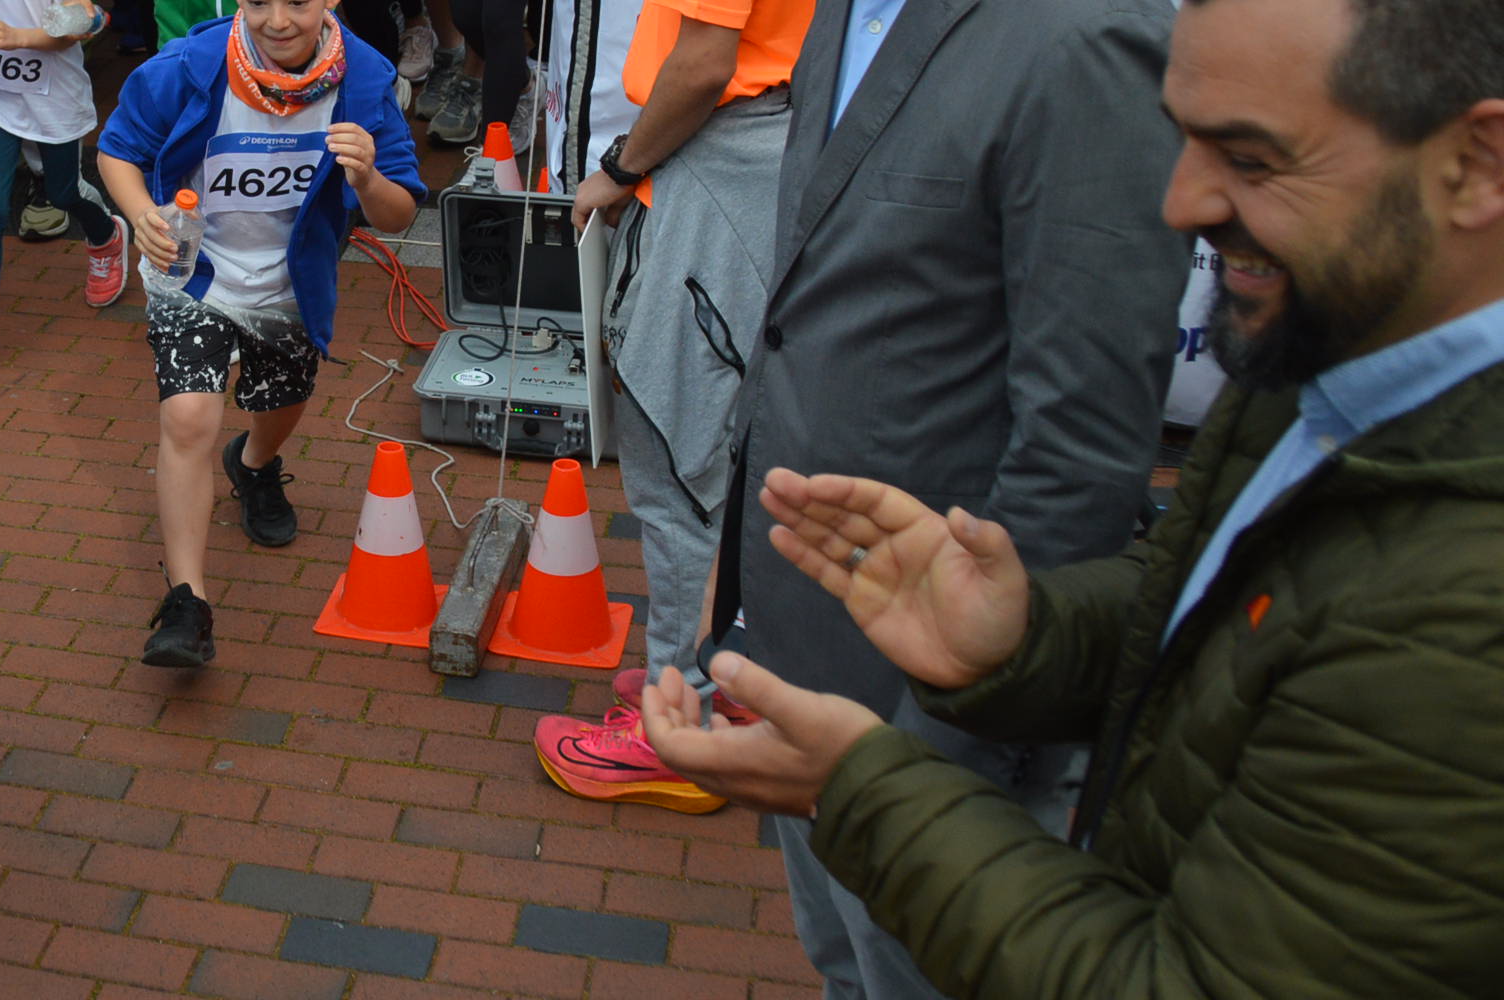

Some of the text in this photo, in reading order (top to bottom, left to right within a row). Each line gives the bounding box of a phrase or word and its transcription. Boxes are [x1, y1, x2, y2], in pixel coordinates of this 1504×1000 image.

[251, 137, 298, 146] DECATHLON
[209, 163, 318, 198] 4629
[520, 376, 577, 388] MYLAPS
